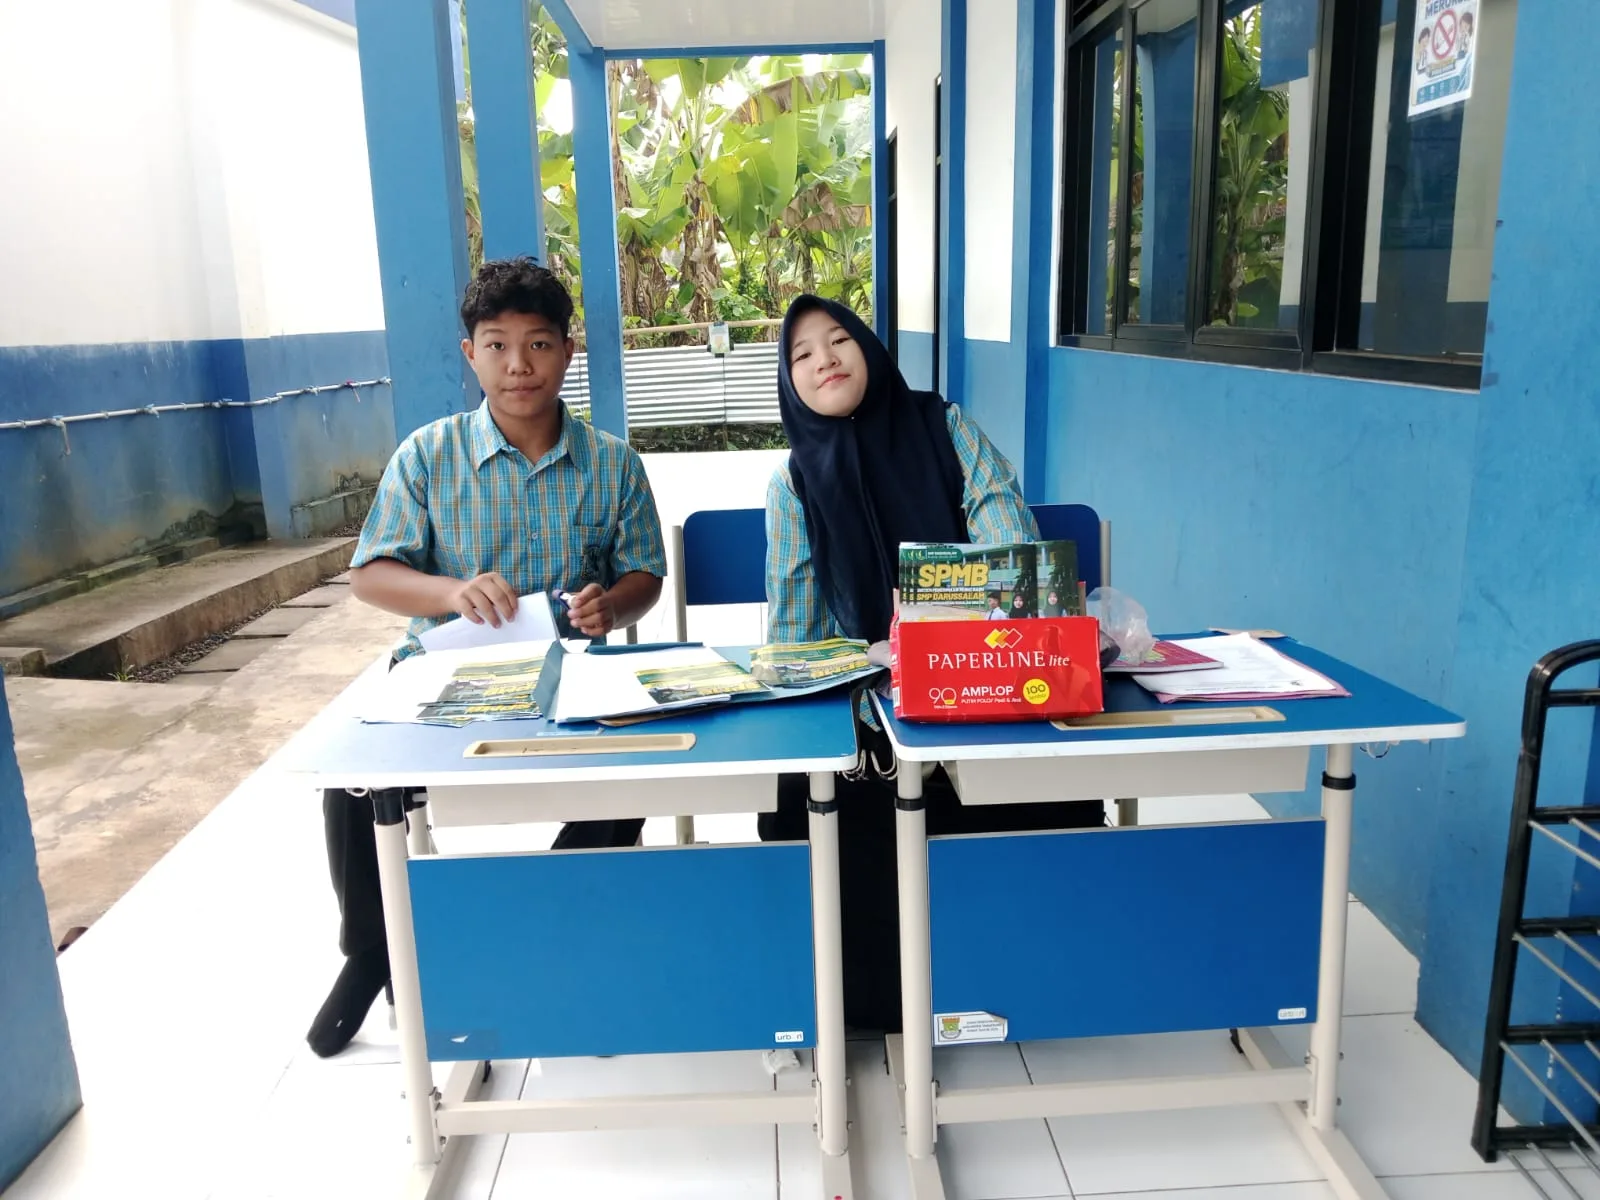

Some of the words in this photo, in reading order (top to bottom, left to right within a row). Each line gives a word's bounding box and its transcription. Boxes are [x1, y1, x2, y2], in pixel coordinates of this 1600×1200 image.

[1425, 0, 1469, 19] MEROK
[918, 563, 989, 588] SPMB
[917, 592, 933, 600] SMP
[933, 592, 985, 600] DARUSSALAM
[927, 651, 1046, 670] PAPERLINE
[1048, 654, 1070, 667] lite
[929, 687, 957, 705] 90
[961, 686, 1014, 697] AMPLOP
[1025, 684, 1046, 695] 100
